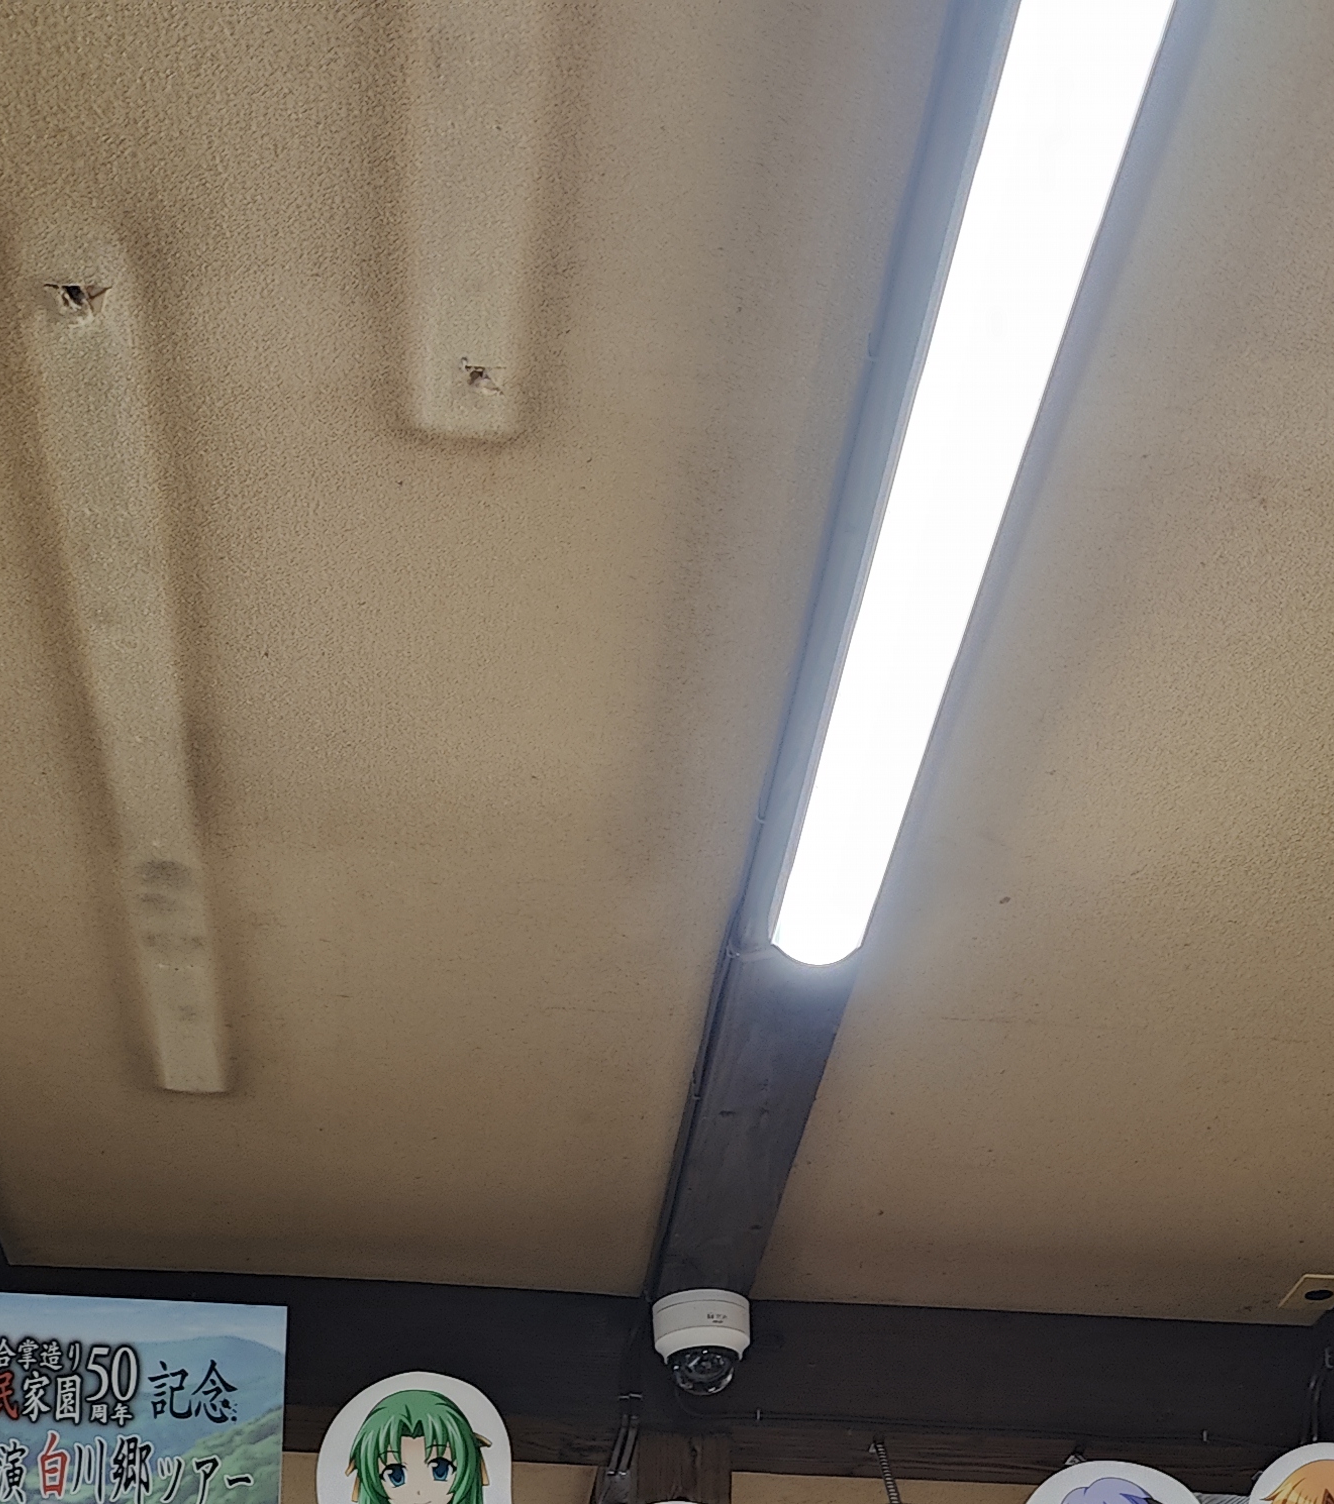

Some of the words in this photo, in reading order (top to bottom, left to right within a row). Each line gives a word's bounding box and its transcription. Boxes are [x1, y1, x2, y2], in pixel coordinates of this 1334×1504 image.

[84, 1346, 140, 1402] 50
[146, 1359, 239, 1424] 記念
[88, 1402, 135, 1427] 周年
